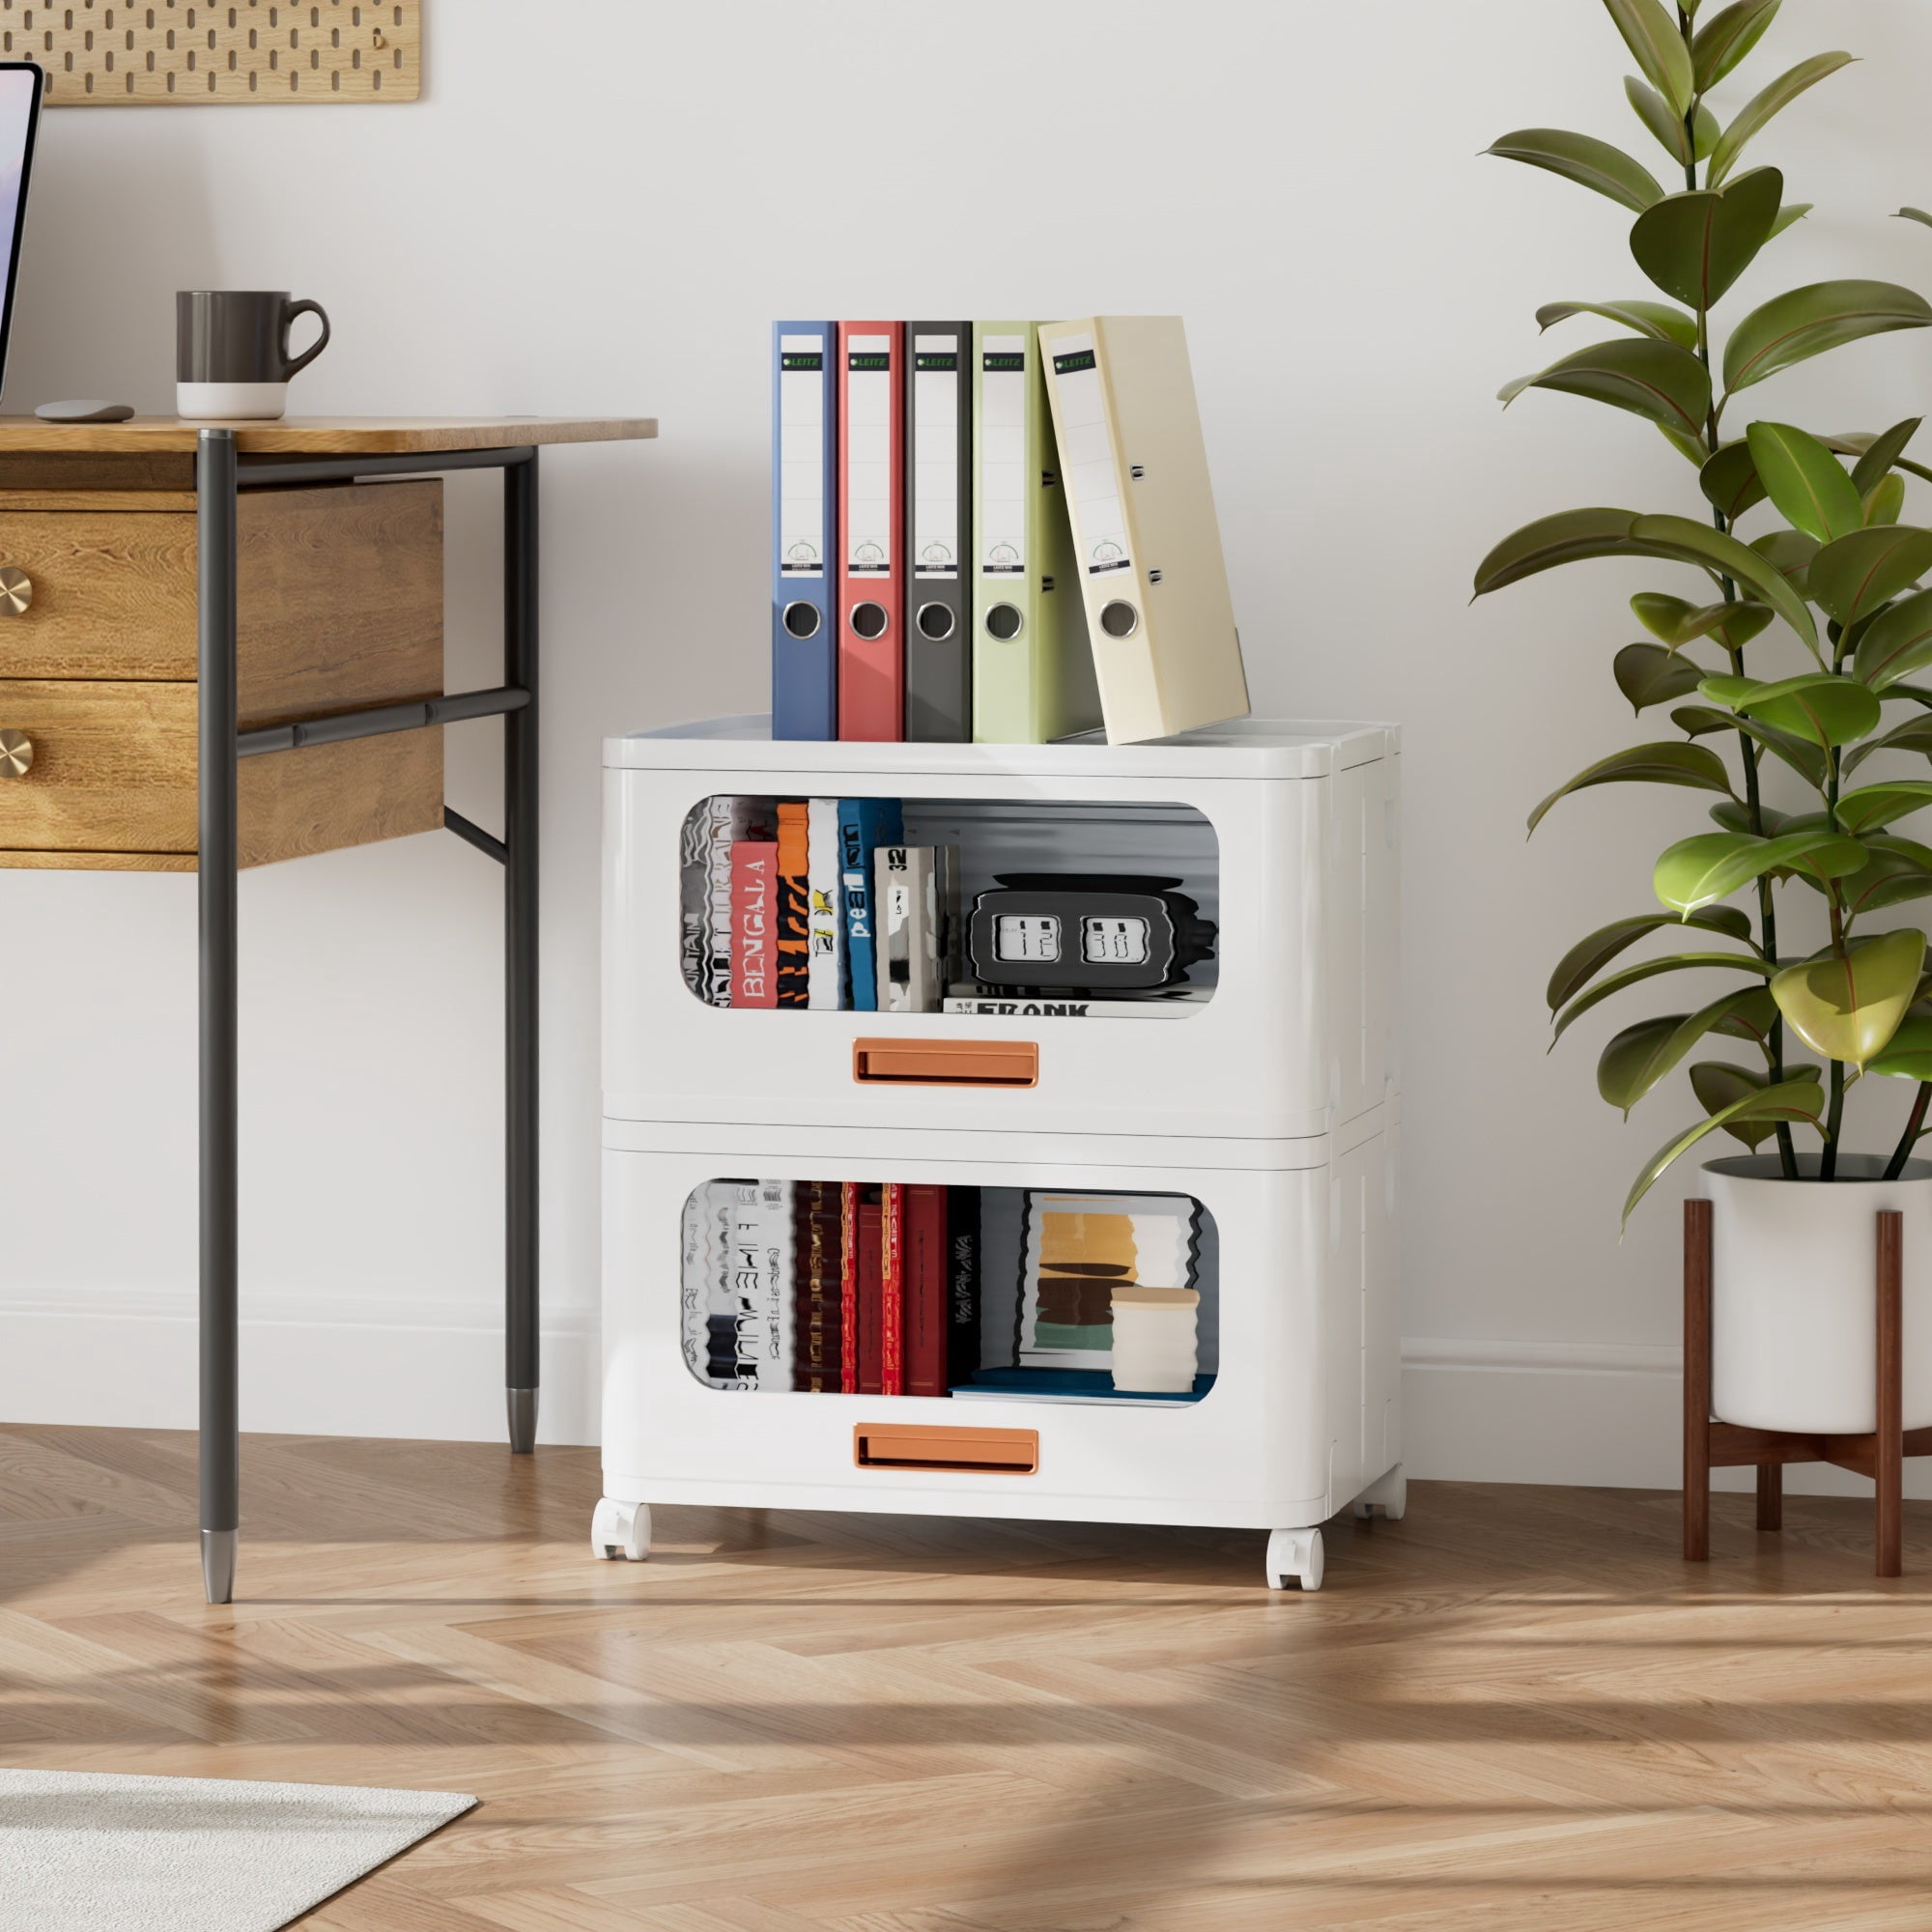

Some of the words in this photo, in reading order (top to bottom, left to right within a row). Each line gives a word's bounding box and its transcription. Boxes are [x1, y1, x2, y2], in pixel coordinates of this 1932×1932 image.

[790, 357, 819, 367] LEITZ
[858, 357, 886, 367] LEITZ
[924, 357, 953, 367] LEITZ
[991, 357, 1020, 367] LEITZ
[1063, 355, 1093, 369] LEITZ
[742, 859, 765, 998] BENGALA
